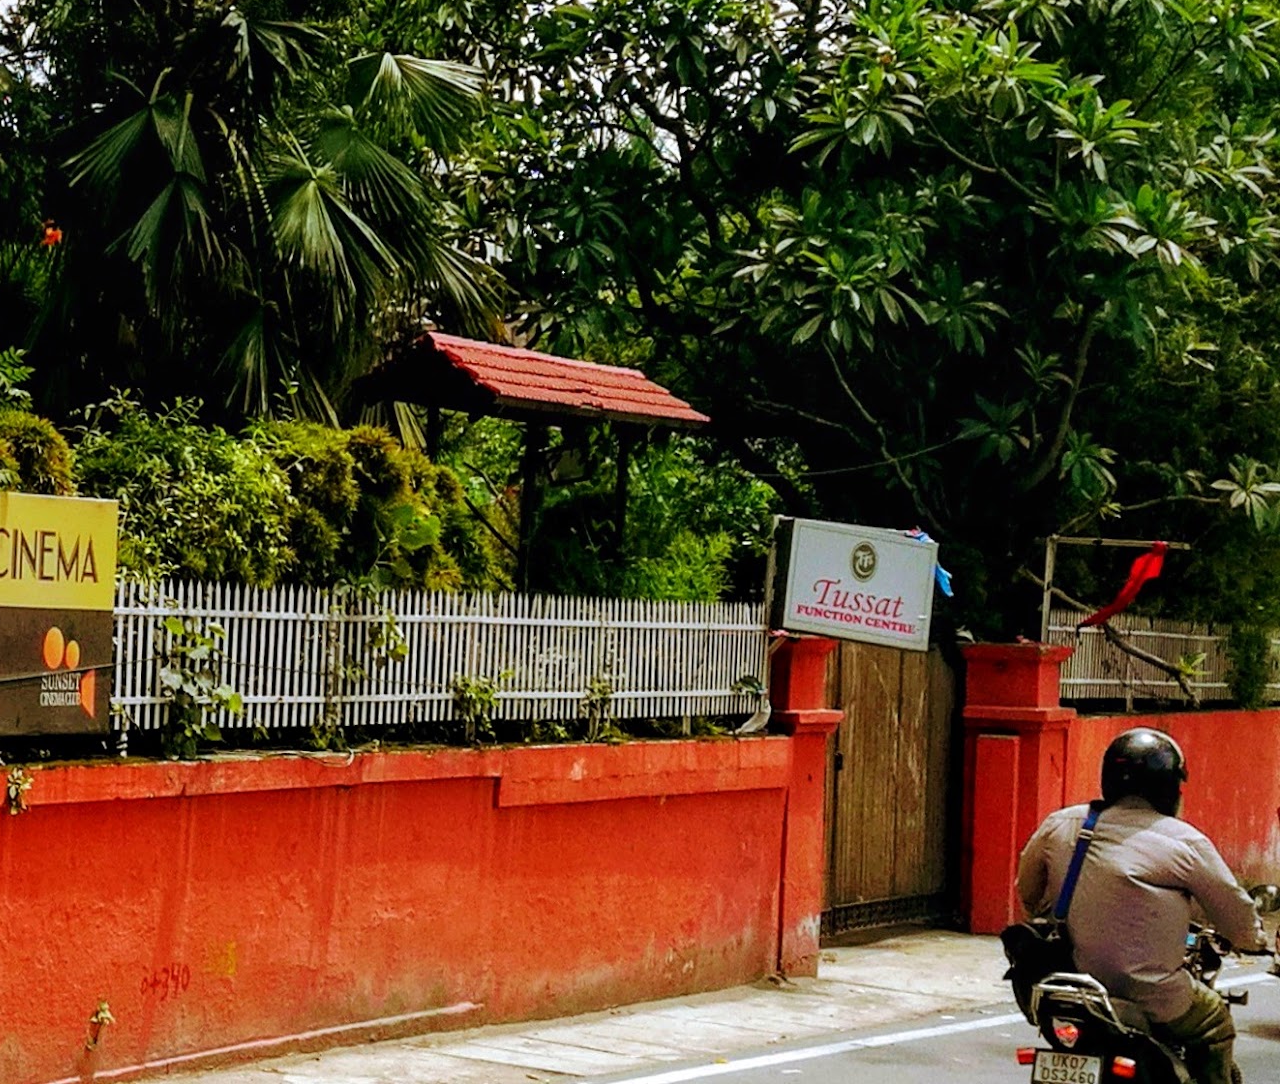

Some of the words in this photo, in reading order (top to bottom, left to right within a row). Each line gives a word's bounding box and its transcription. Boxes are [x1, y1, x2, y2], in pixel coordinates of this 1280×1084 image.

[813, 579, 905, 618] Tussat
[796, 604, 862, 624] FUNCTION
[865, 617, 916, 634] CENTRE
[41, 672, 81, 690] SUNSET
[1052, 1054, 1088, 1070] UK07
